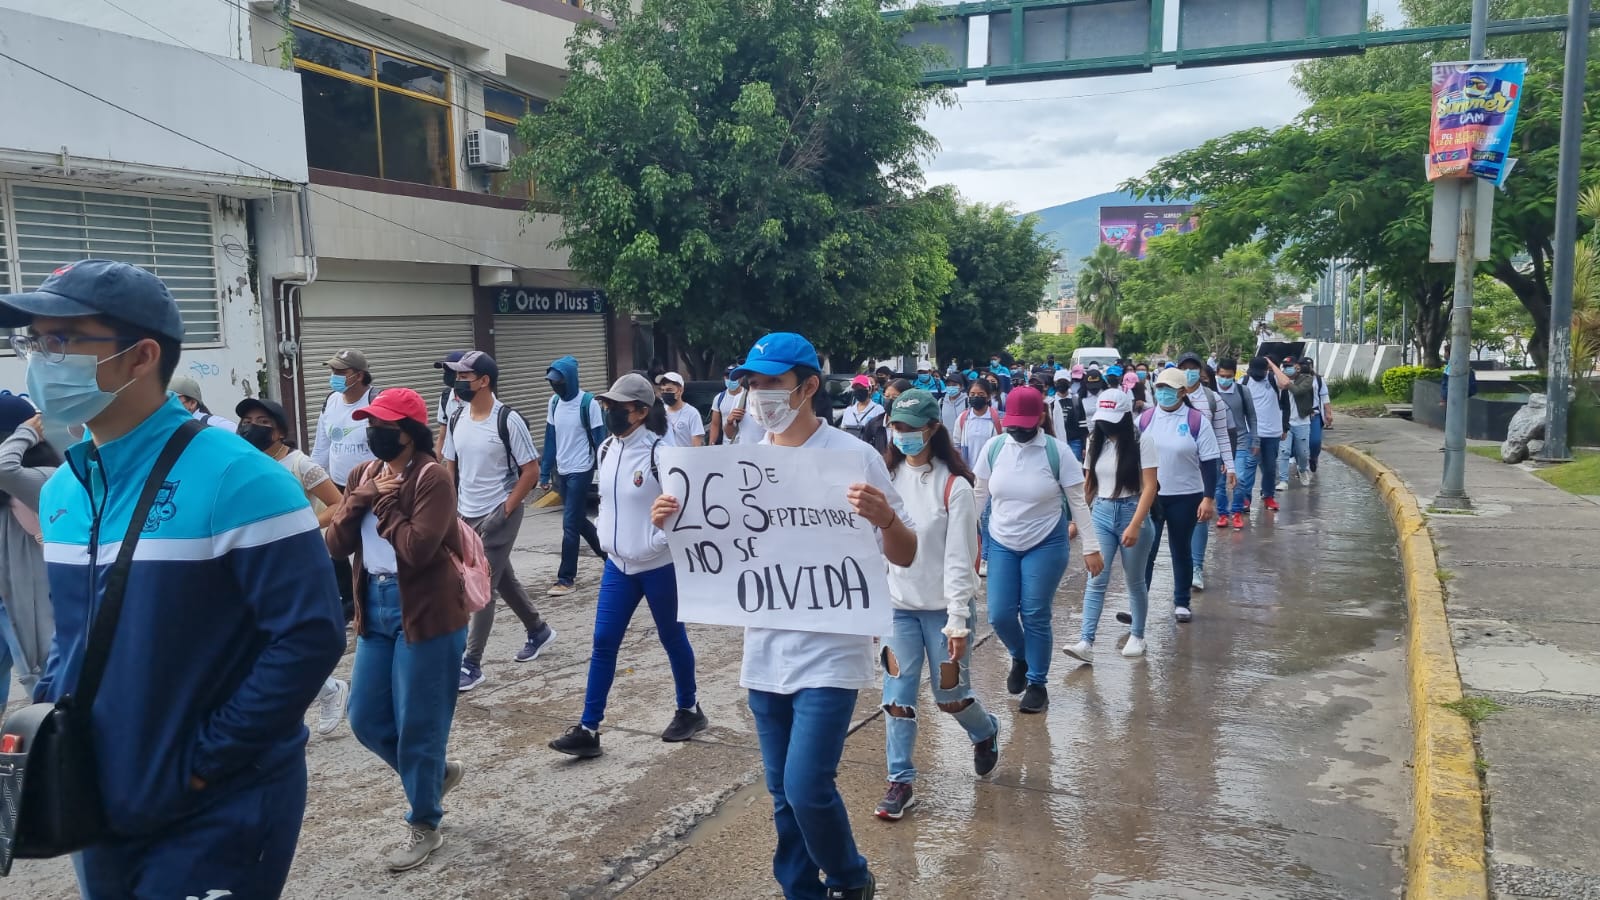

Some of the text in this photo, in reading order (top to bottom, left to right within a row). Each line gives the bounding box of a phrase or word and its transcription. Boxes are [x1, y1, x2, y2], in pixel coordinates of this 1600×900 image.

[1437, 92, 1513, 117] Summer
[515, 290, 588, 310] Orto Pluss
[668, 460, 779, 533] 26 DE
[684, 536, 760, 575] NO SE
[737, 555, 870, 613] OLVIDA
